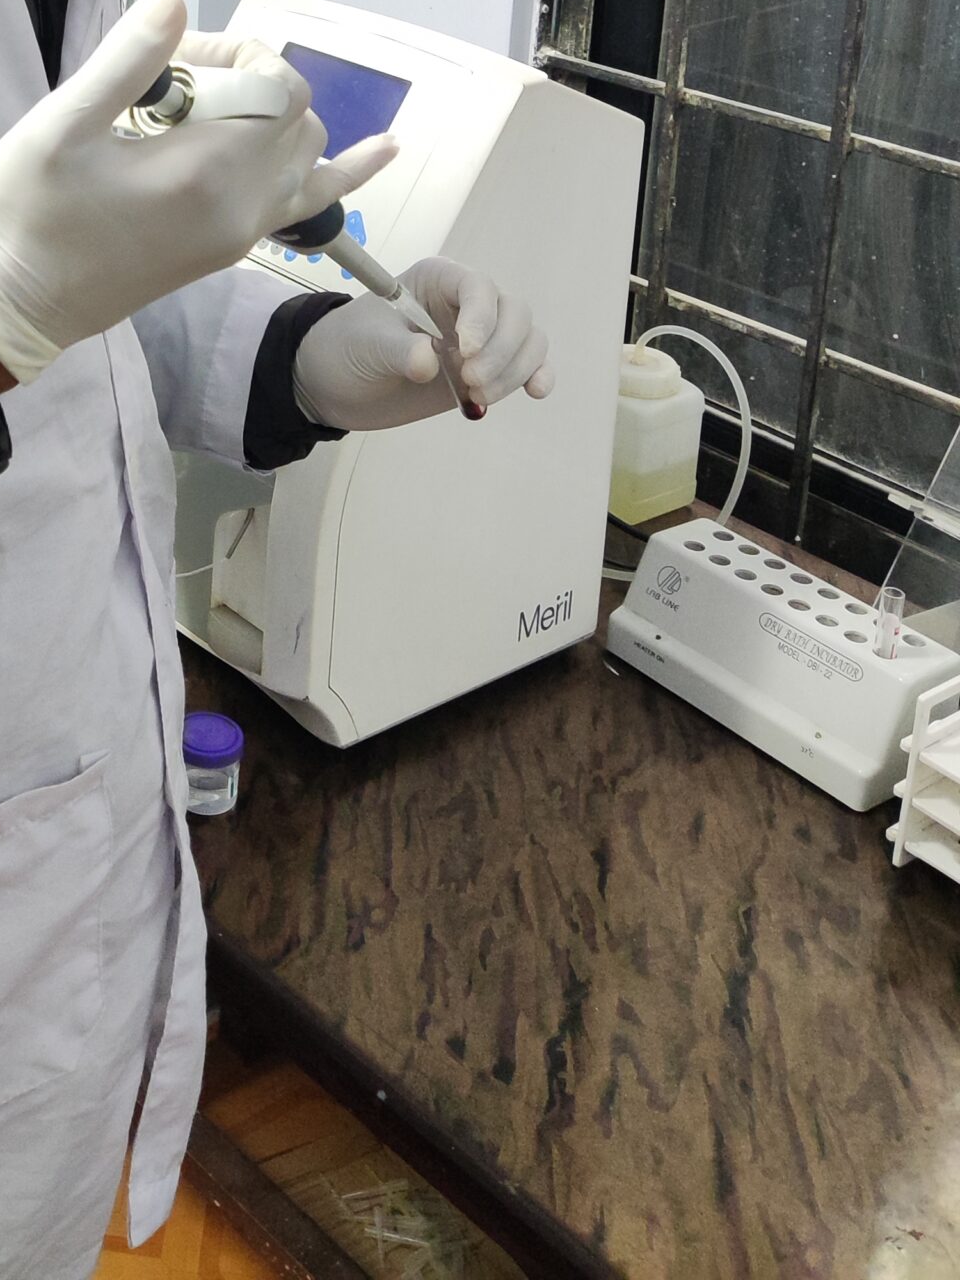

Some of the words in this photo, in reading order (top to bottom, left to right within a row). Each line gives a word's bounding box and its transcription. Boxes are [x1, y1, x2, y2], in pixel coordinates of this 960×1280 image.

[646, 587, 661, 600] LAB
[662, 597, 679, 612] LINE
[518, 590, 573, 642] Meril
[778, 642, 800, 662] MODEL
[810, 644, 860, 679] INCUBATOR
